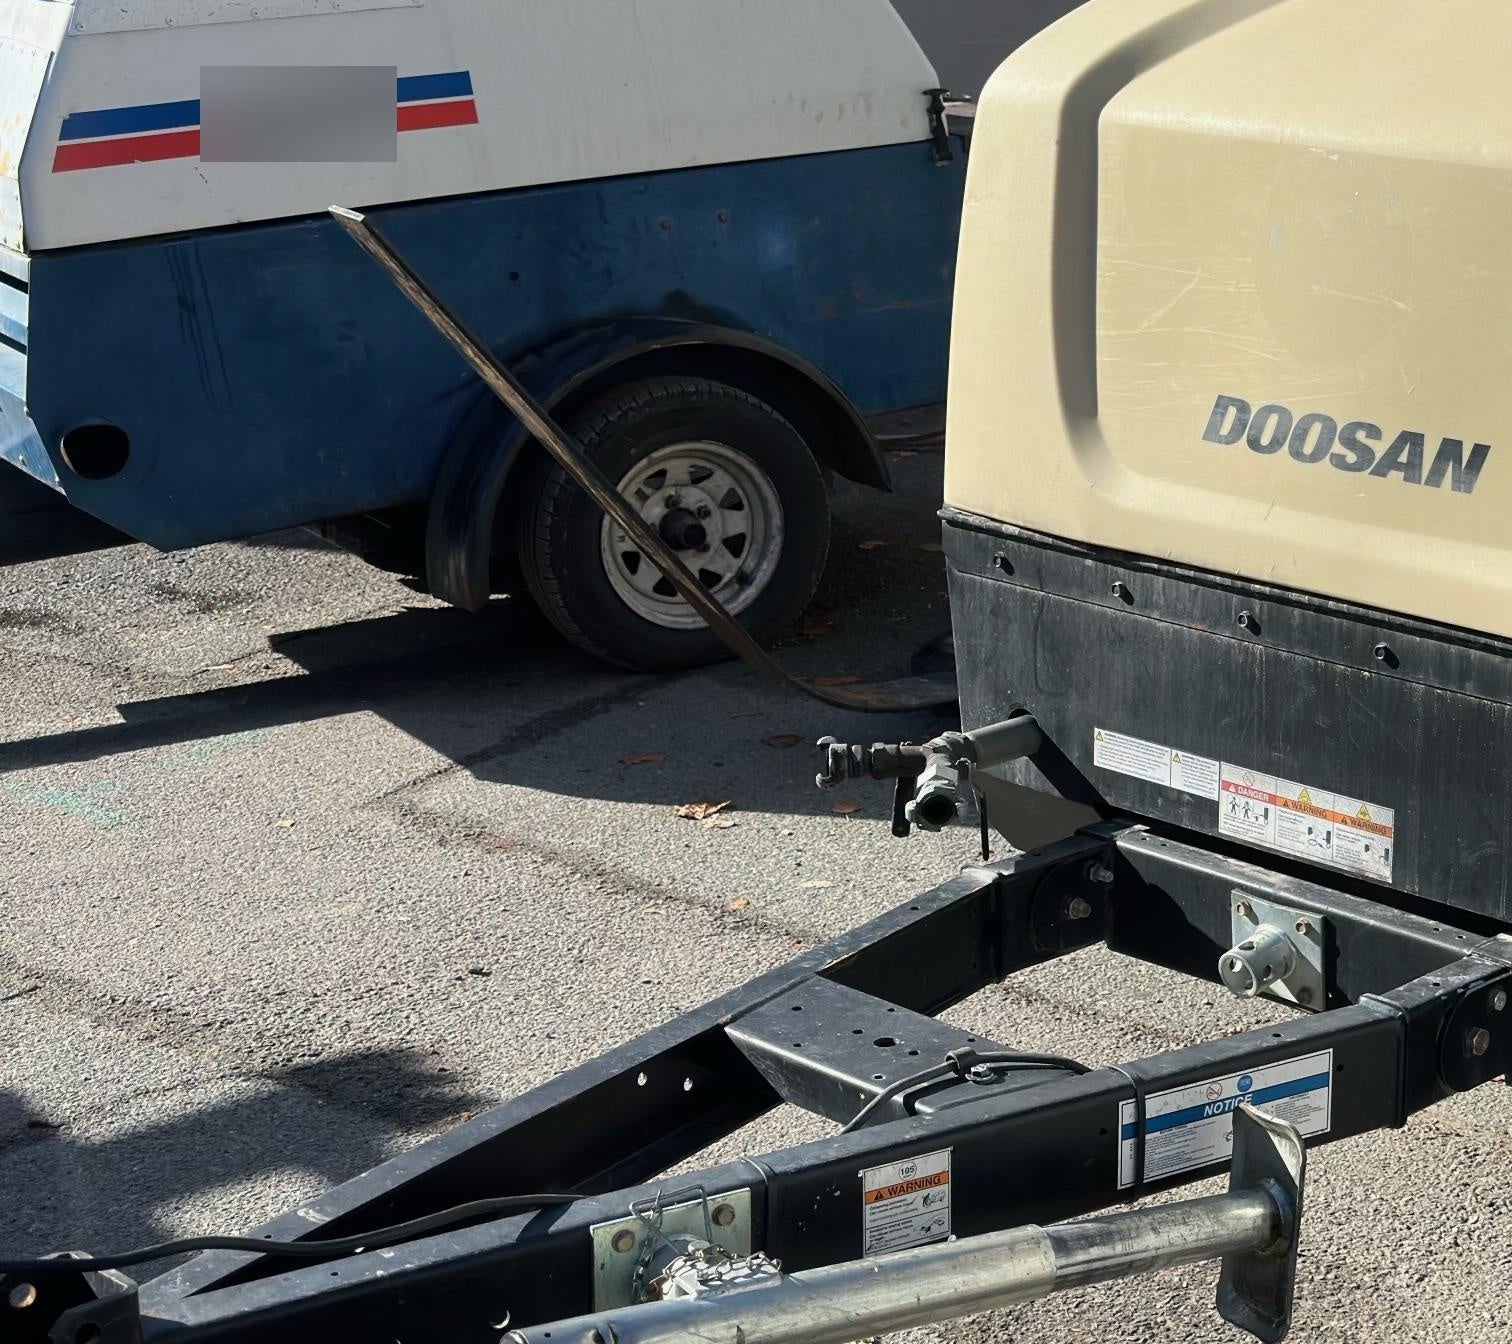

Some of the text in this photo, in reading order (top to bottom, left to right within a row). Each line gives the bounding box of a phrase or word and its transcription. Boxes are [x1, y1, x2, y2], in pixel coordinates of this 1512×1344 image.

[1201, 394, 1491, 494] DOOSAN
[1237, 785, 1269, 802] DANGER
[1291, 801, 1327, 819] WARNING
[1350, 817, 1387, 835] WARNING
[901, 1166, 915, 1176] 105
[888, 1175, 941, 1197] WARNING
